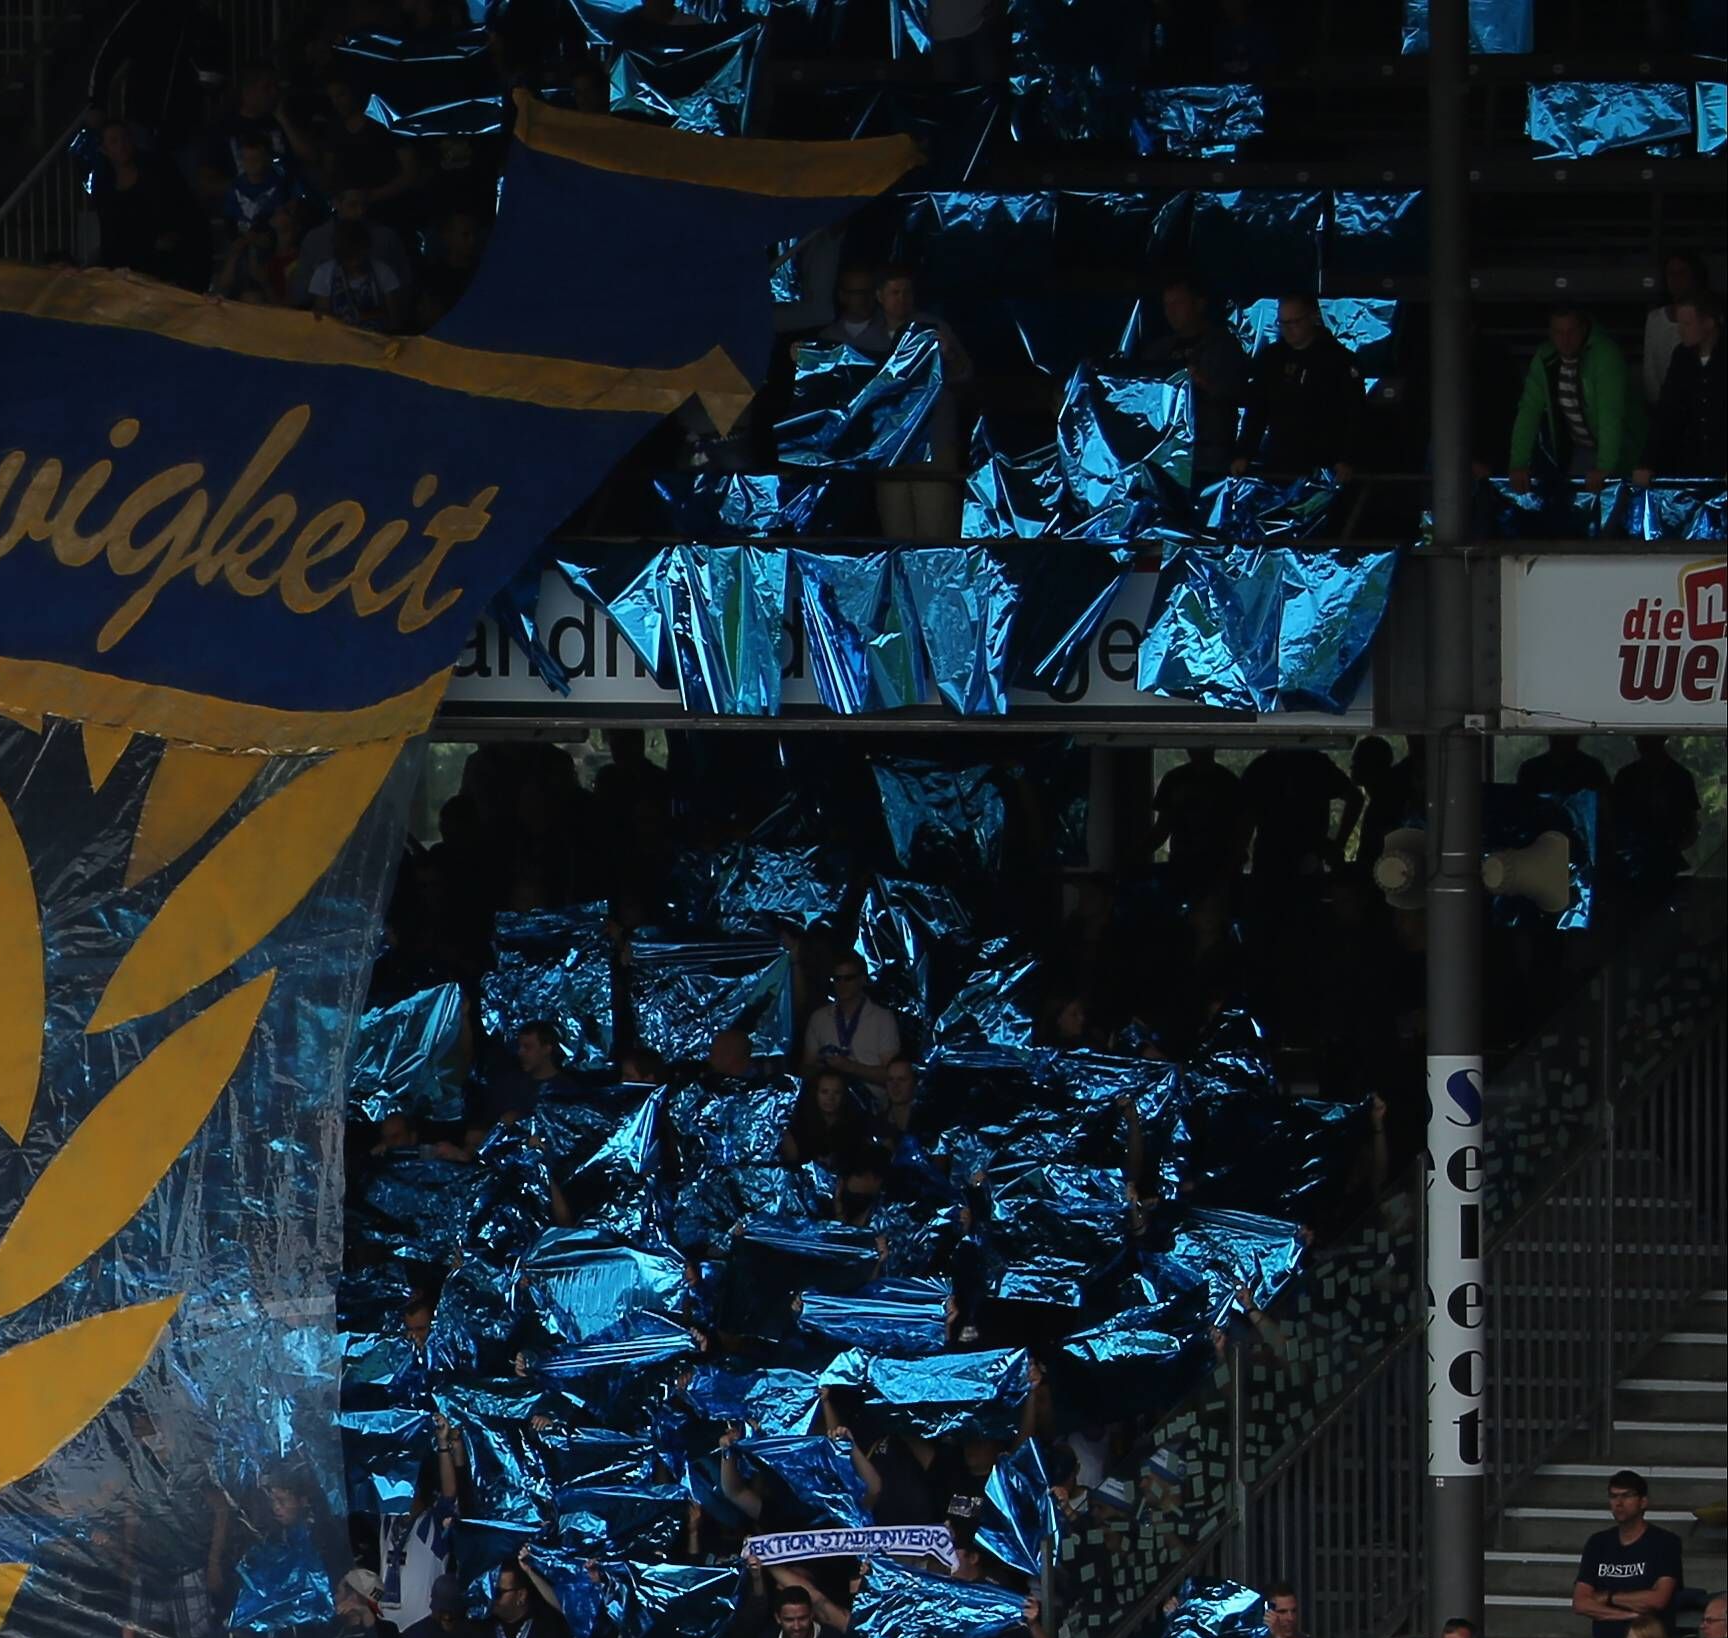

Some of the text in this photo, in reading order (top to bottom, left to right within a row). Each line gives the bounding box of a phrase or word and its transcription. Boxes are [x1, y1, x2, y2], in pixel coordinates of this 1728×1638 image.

[1622, 598, 1685, 641] die
[1446, 1068, 1483, 1466] Select
[1597, 1562, 1646, 1578] BOSTON
